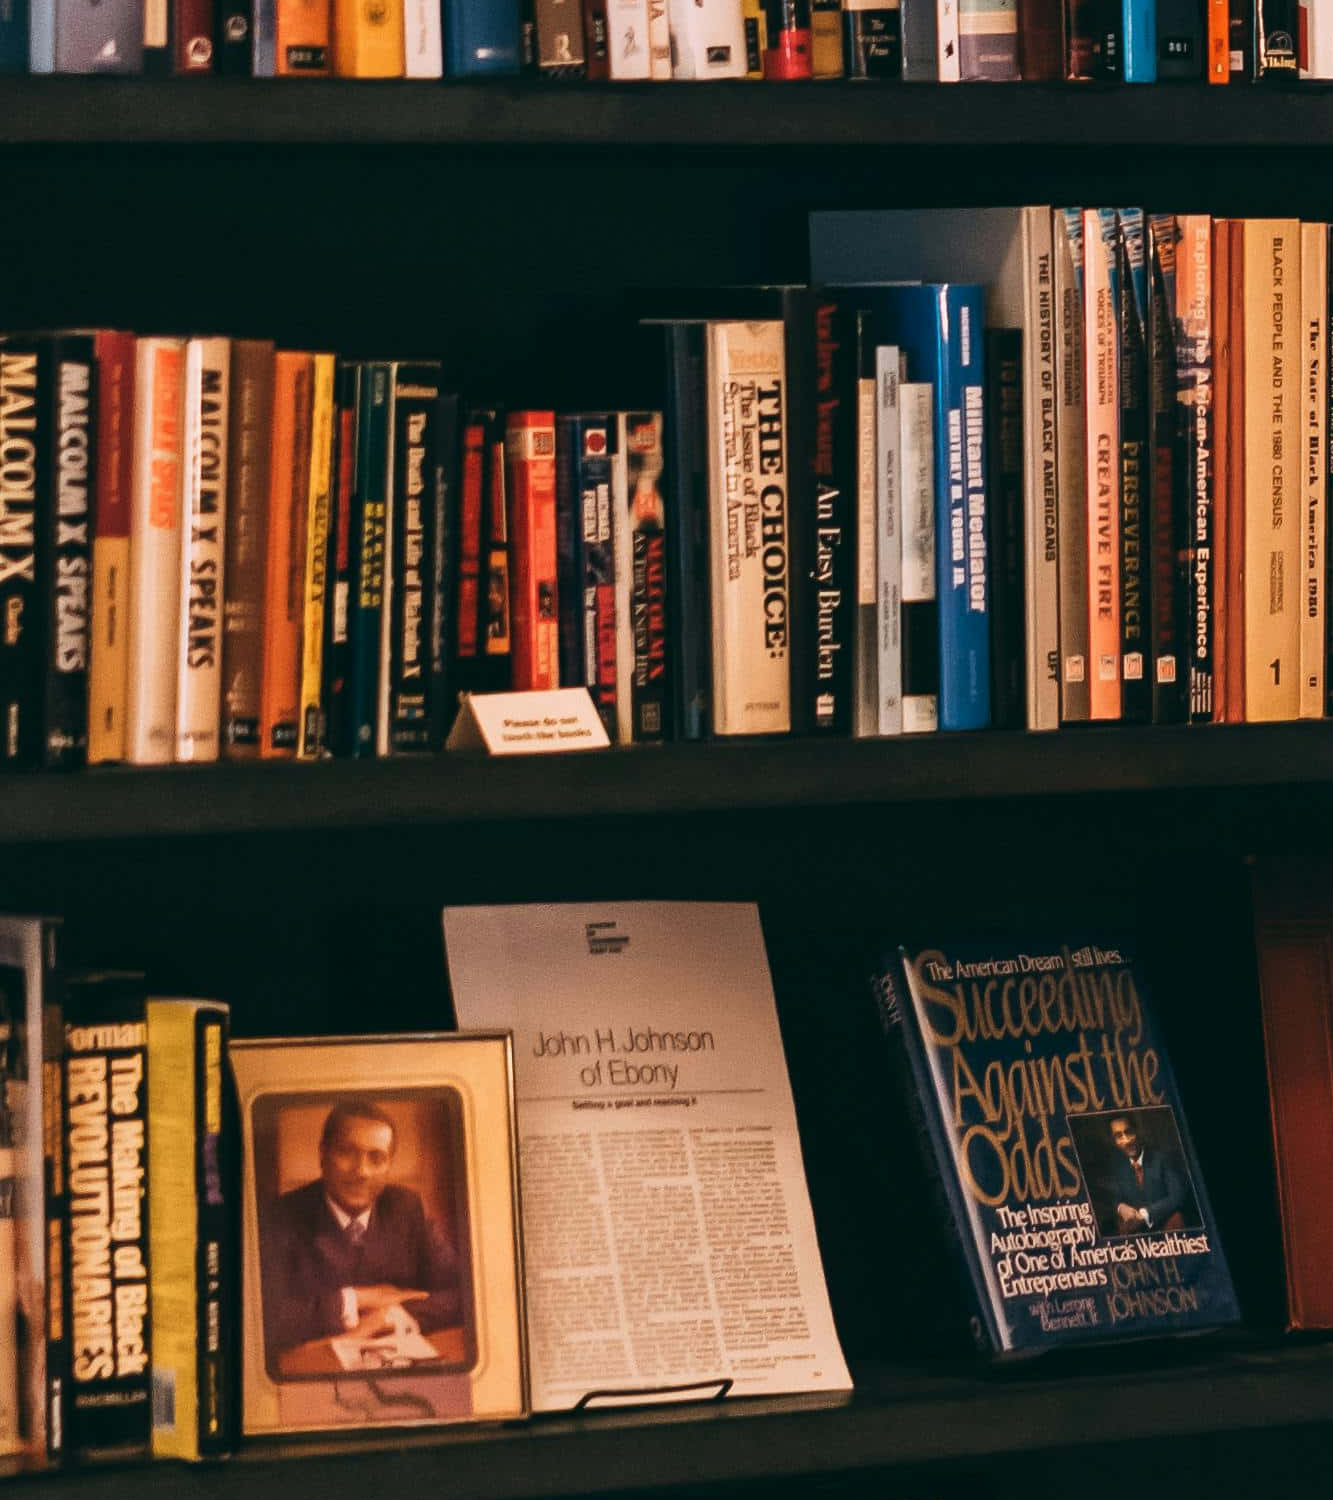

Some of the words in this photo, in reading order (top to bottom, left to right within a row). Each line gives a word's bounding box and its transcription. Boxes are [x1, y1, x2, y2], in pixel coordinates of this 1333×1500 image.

[758, 381, 784, 475] THE
[818, 483, 841, 520] An
[759, 485, 788, 660] CHOICE:
[810, 526, 840, 584] Easy
[817, 589, 840, 680] Burden
[913, 946, 1143, 1046] Succeeding
[111, 1055, 141, 1112] The
[533, 1030, 588, 1057] John
[581, 1061, 602, 1088] of
[609, 1058, 681, 1090] Ebony
[951, 1033, 1105, 1143] Against
[1099, 1034, 1164, 1107] the
[111, 1119, 144, 1239] Making
[957, 1115, 1082, 1207] Odds
[66, 1057, 113, 1383] REVOLUTIONARIES
[114, 1247, 144, 1278] of
[115, 1285, 148, 1377] Black
